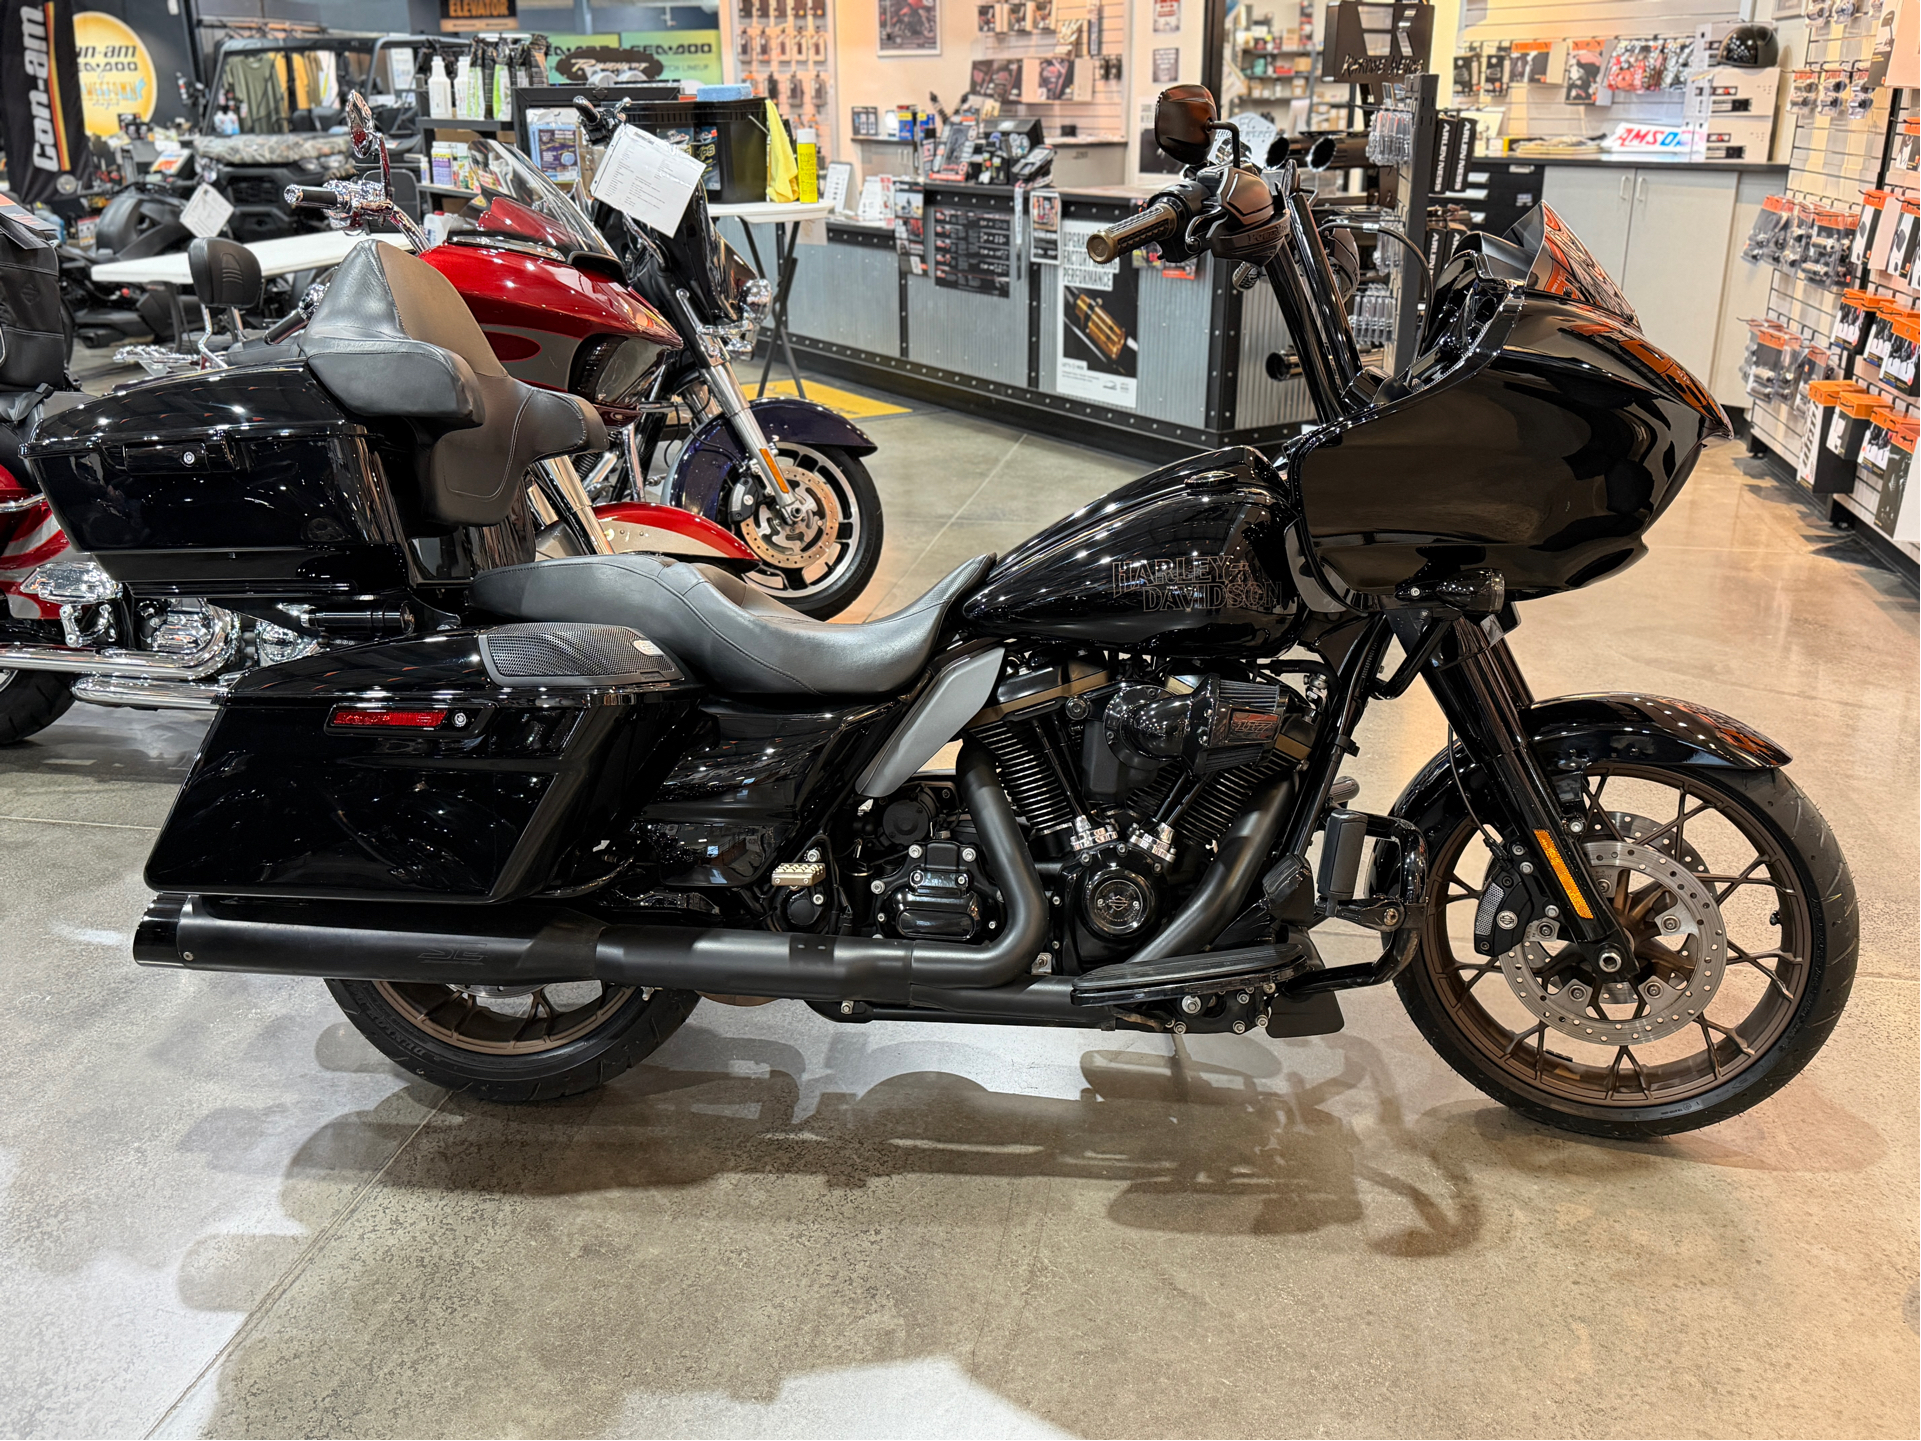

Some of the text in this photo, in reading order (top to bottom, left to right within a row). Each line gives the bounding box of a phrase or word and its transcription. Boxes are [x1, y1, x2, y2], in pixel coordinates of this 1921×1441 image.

[448, 0, 510, 17] ELEVATOR
[20, 6, 59, 172] can-am
[1062, 266, 1112, 289] PERFORMANCE
[1142, 581, 1283, 612] DAVIDSON
